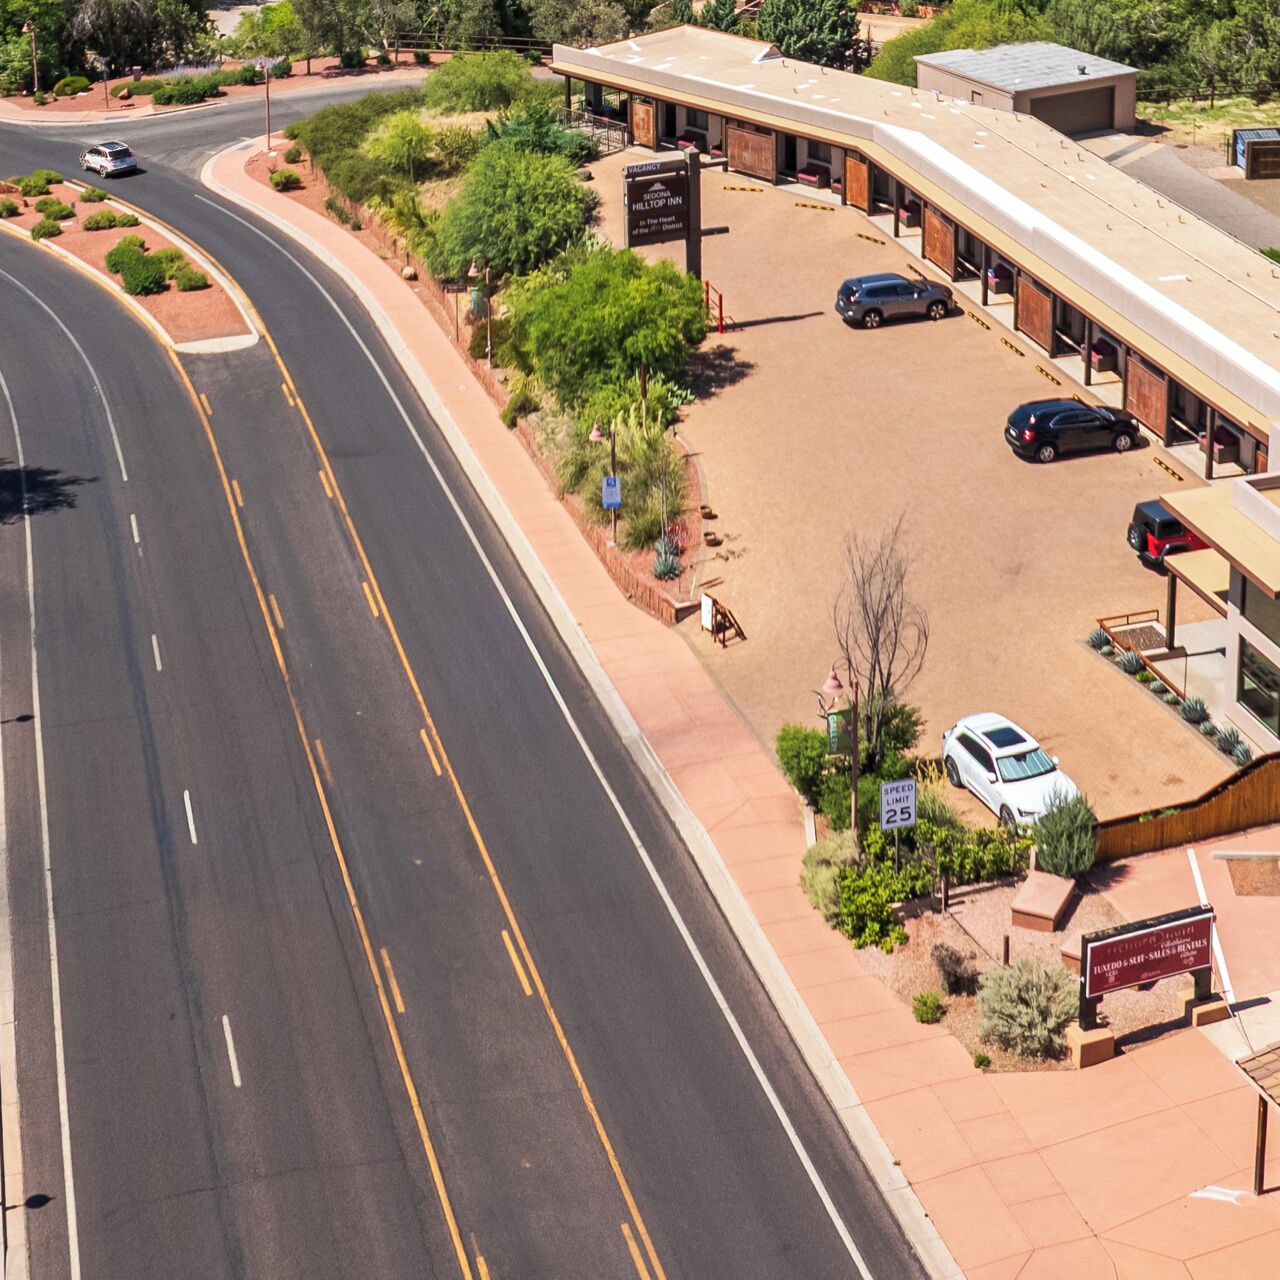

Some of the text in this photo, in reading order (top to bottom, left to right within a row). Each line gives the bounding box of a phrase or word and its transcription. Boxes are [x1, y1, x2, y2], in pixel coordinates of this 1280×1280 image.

[628, 163, 660, 173] VACANCY
[644, 190, 671, 200] SEDONA
[632, 196, 682, 211] HILLTOP INN
[662, 222, 682, 231] District
[883, 784, 913, 795] SPEED
[886, 795, 910, 806] LIMIT
[885, 806, 911, 825] 25
[1093, 960, 1122, 975] TUXEDO
[1177, 938, 1207, 953] RENTALS
